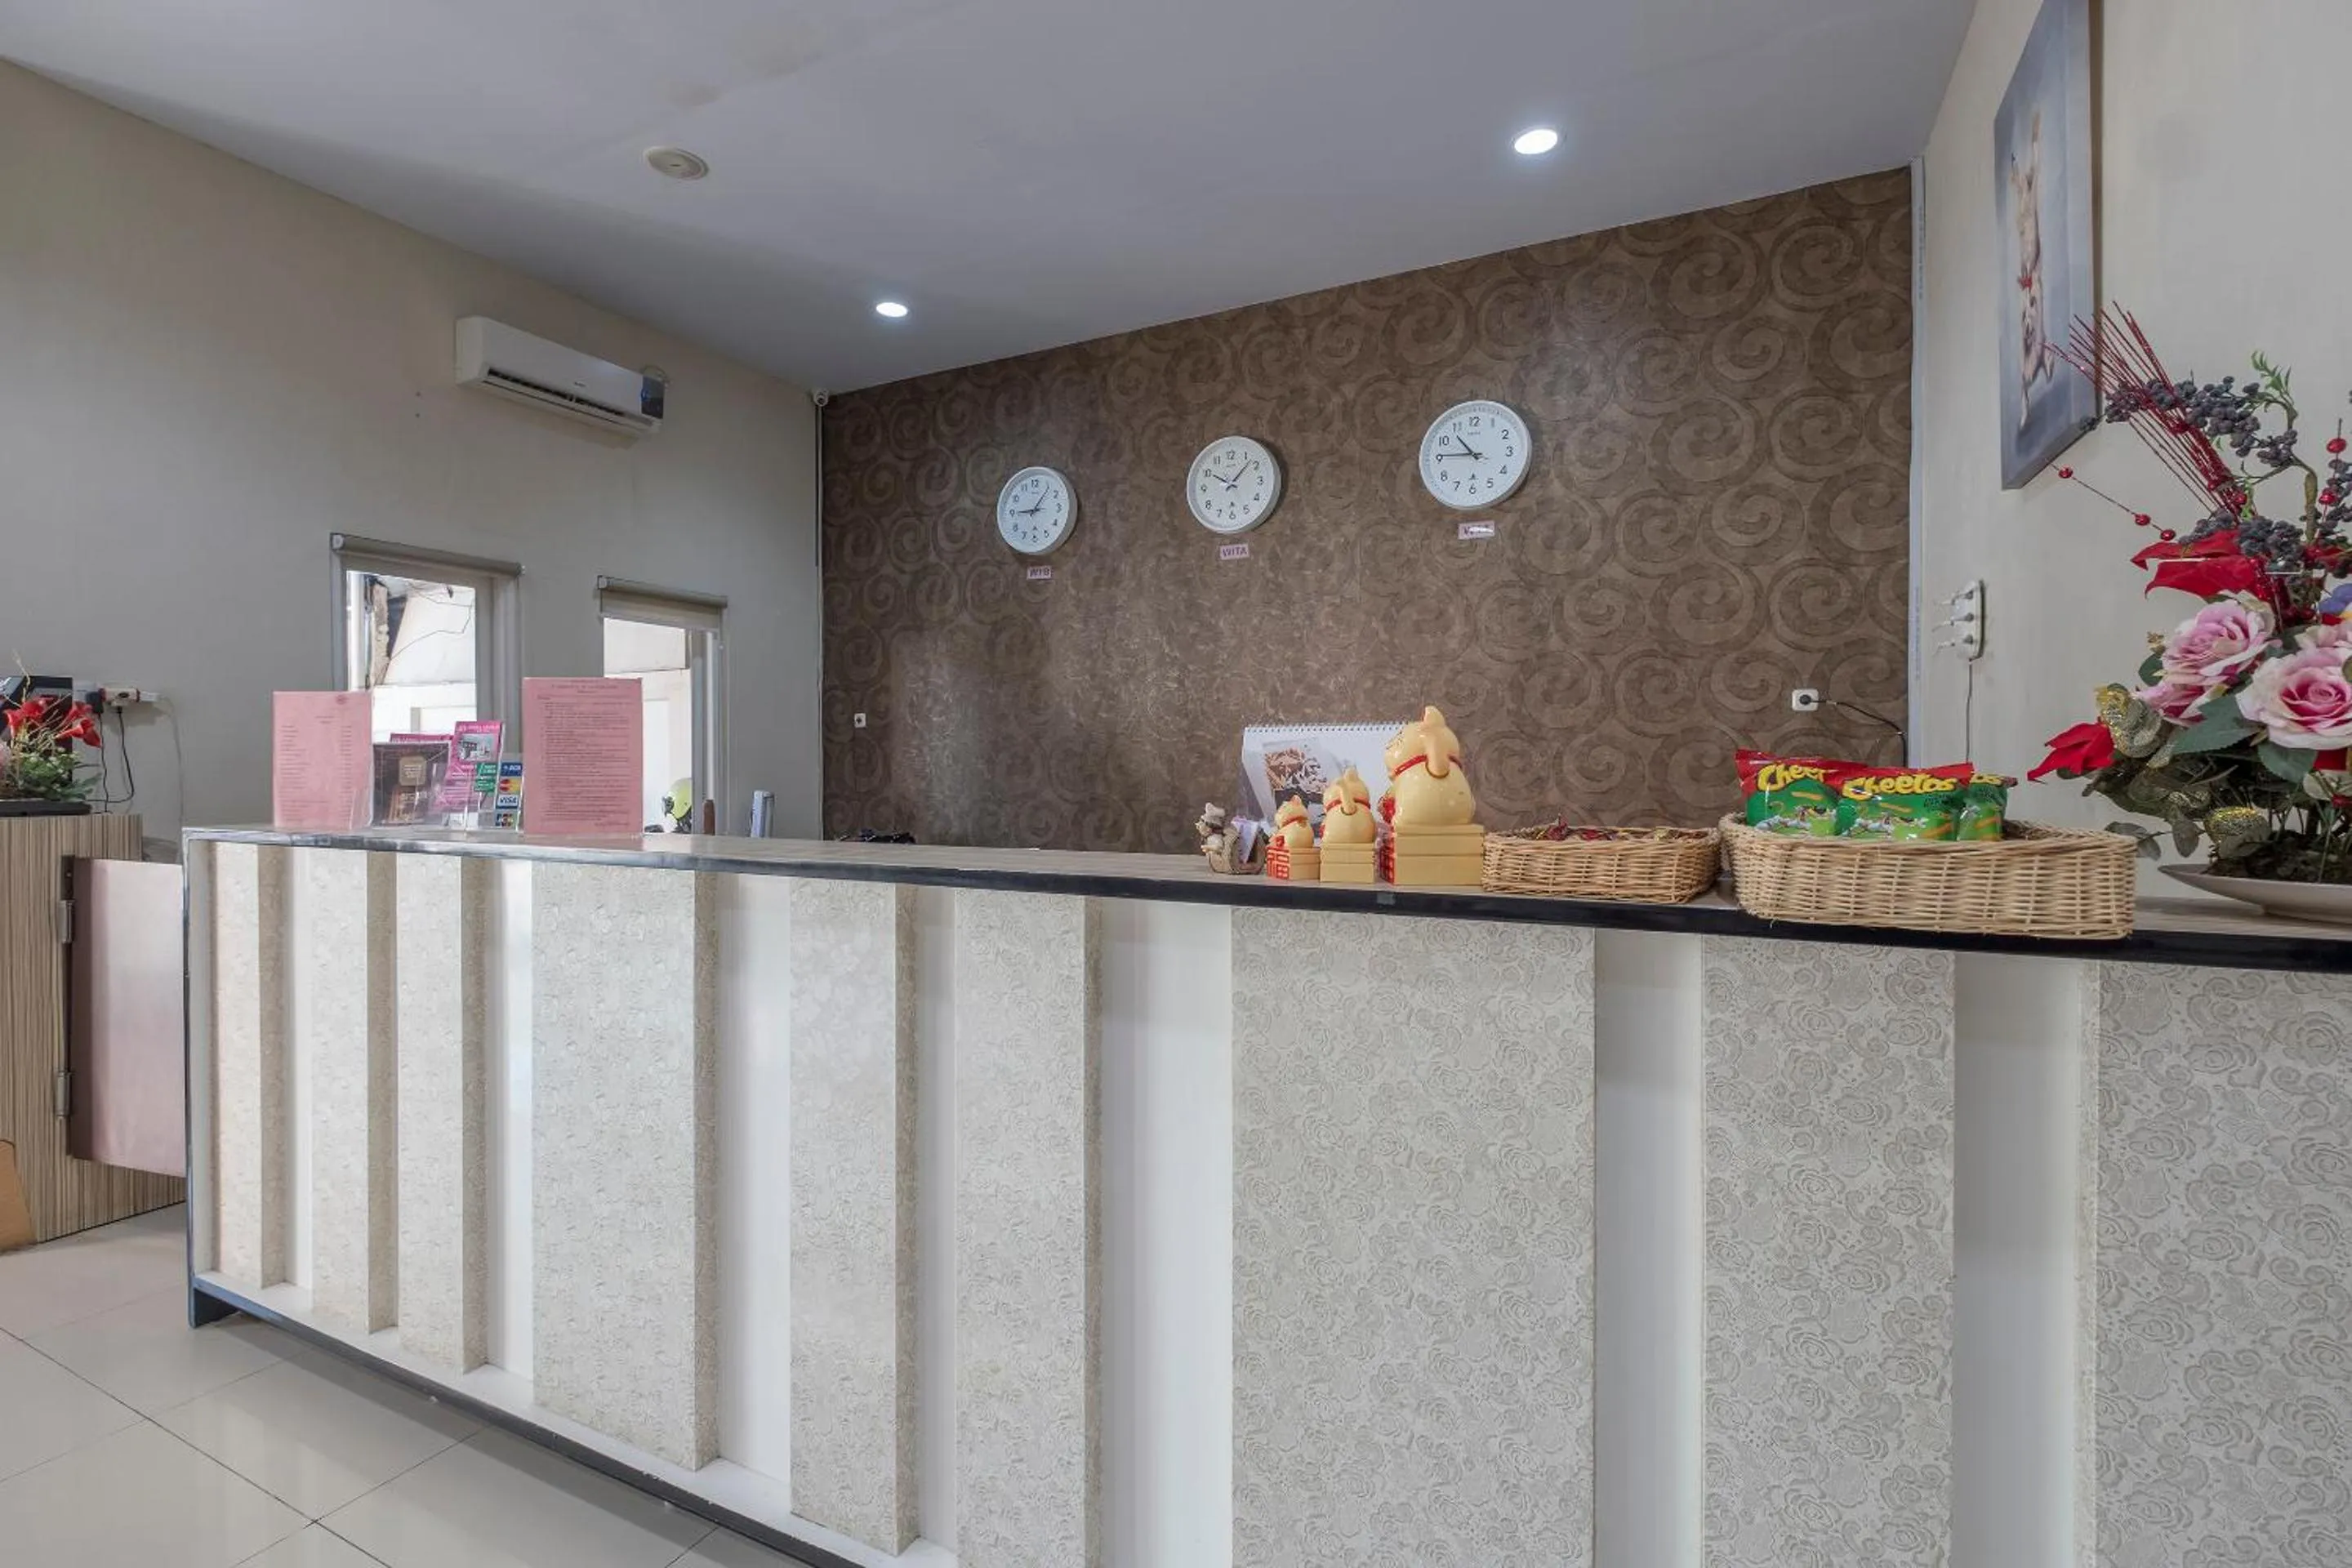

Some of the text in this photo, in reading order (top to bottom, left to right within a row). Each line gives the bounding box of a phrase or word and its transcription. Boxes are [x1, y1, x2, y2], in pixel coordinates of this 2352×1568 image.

[1469, 416, 1481, 426] 12
[1453, 421, 1462, 433] 11
[1502, 429, 1509, 439] 2
[1439, 435, 1450, 447] 10
[1226, 449, 1236, 460] 12
[1506, 445, 1513, 457] 3
[1214, 455, 1221, 465] 11
[1436, 453, 1443, 464] 9
[1253, 460, 1260, 471] 2
[1499, 465, 1508, 474] 4
[1257, 475, 1264, 486] 3
[1441, 470, 1448, 482] 8
[1031, 479, 1040, 488] 12
[1454, 480, 1461, 491] 7
[1486, 477, 1494, 488] 5
[1054, 489, 1059, 499] 2
[1468, 483, 1477, 494] 6
[1254, 492, 1260, 501] 4
[1205, 499, 1212, 510] 8
[1242, 504, 1250, 515] 5
[1216, 508, 1223, 518] 7
[1228, 510, 1236, 520] 6
[1021, 531, 1027, 540] 7
[1029, 566, 1050, 577] WIB
[1842, 773, 1958, 801] Cheetos
